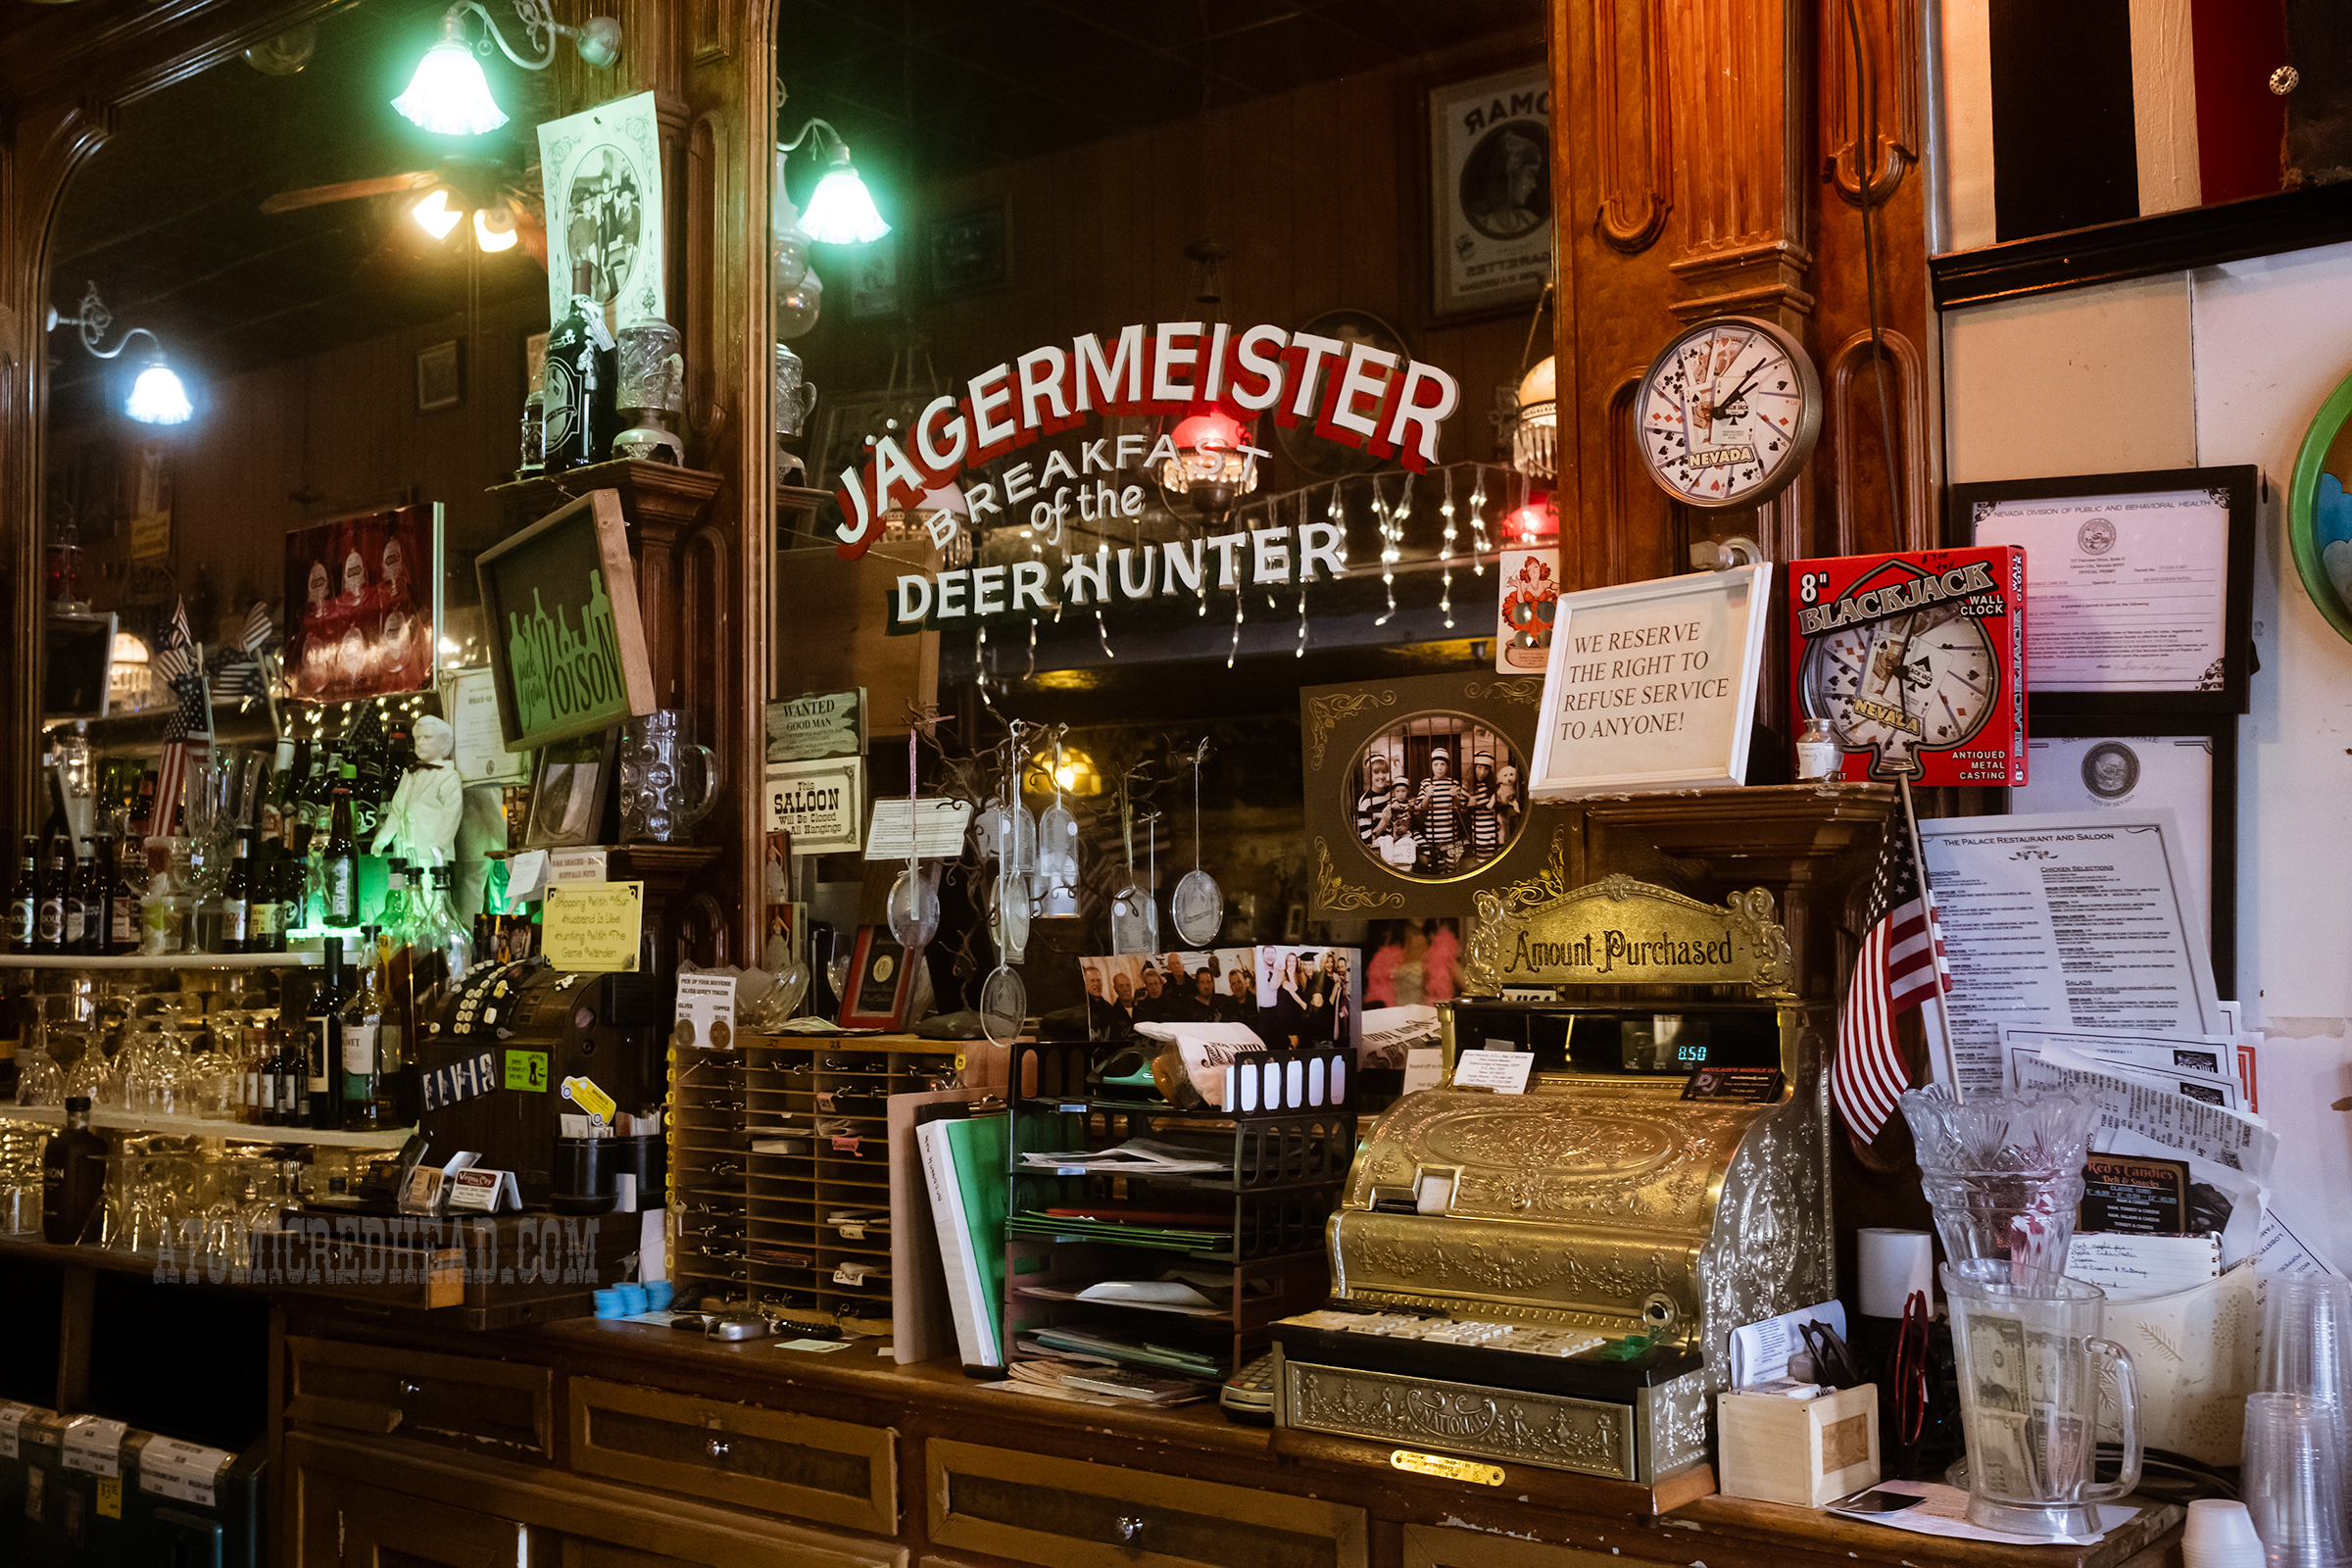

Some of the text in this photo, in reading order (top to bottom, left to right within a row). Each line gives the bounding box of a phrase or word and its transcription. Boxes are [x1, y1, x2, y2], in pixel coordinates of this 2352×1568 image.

[835, 320, 1460, 545] JÄGERMEISTER
[1688, 447, 1755, 469] NEVADA
[926, 434, 1274, 551] BREAKFAST
[1030, 478, 1147, 546] of the
[1994, 510, 2024, 518] NEVADA
[2027, 508, 2058, 516] DIVISION
[2075, 505, 2102, 514] PUBLIC
[2125, 502, 2176, 511] BEHAVIORAL
[896, 521, 1350, 623] DEER HUNTER
[1797, 562, 1993, 636] BLACKJACK
[1960, 604, 2004, 616] CLOCK
[1969, 595, 2004, 605] WALL
[1574, 621, 1701, 655] WE RESERVE
[1569, 650, 1709, 684] THE RIGHT TO
[1563, 677, 1730, 712] REFUSE SERVICE
[783, 699, 835, 718] WANTED
[1853, 698, 1922, 737] NEVADA
[786, 717, 832, 732] GOOD MAN
[1560, 711, 1685, 741] TO ANYONE!
[1951, 751, 2006, 760] ANTIQUED
[1971, 760, 2006, 769] METAL
[798, 782, 815, 791] This
[1959, 770, 2006, 781] CASTING
[774, 788, 840, 815] SALOON
[778, 811, 837, 825] Will Be Closed
[790, 826, 802, 835] All
[805, 823, 842, 836] Hangings
[1503, 929, 1734, 974] Amount Purchased
[2087, 1160, 2175, 1180] Red's Candies
[2102, 1174, 2120, 1184] Deli
[2131, 1177, 2160, 1189] Snacks
[1420, 1407, 1486, 1435] NATIONAL
